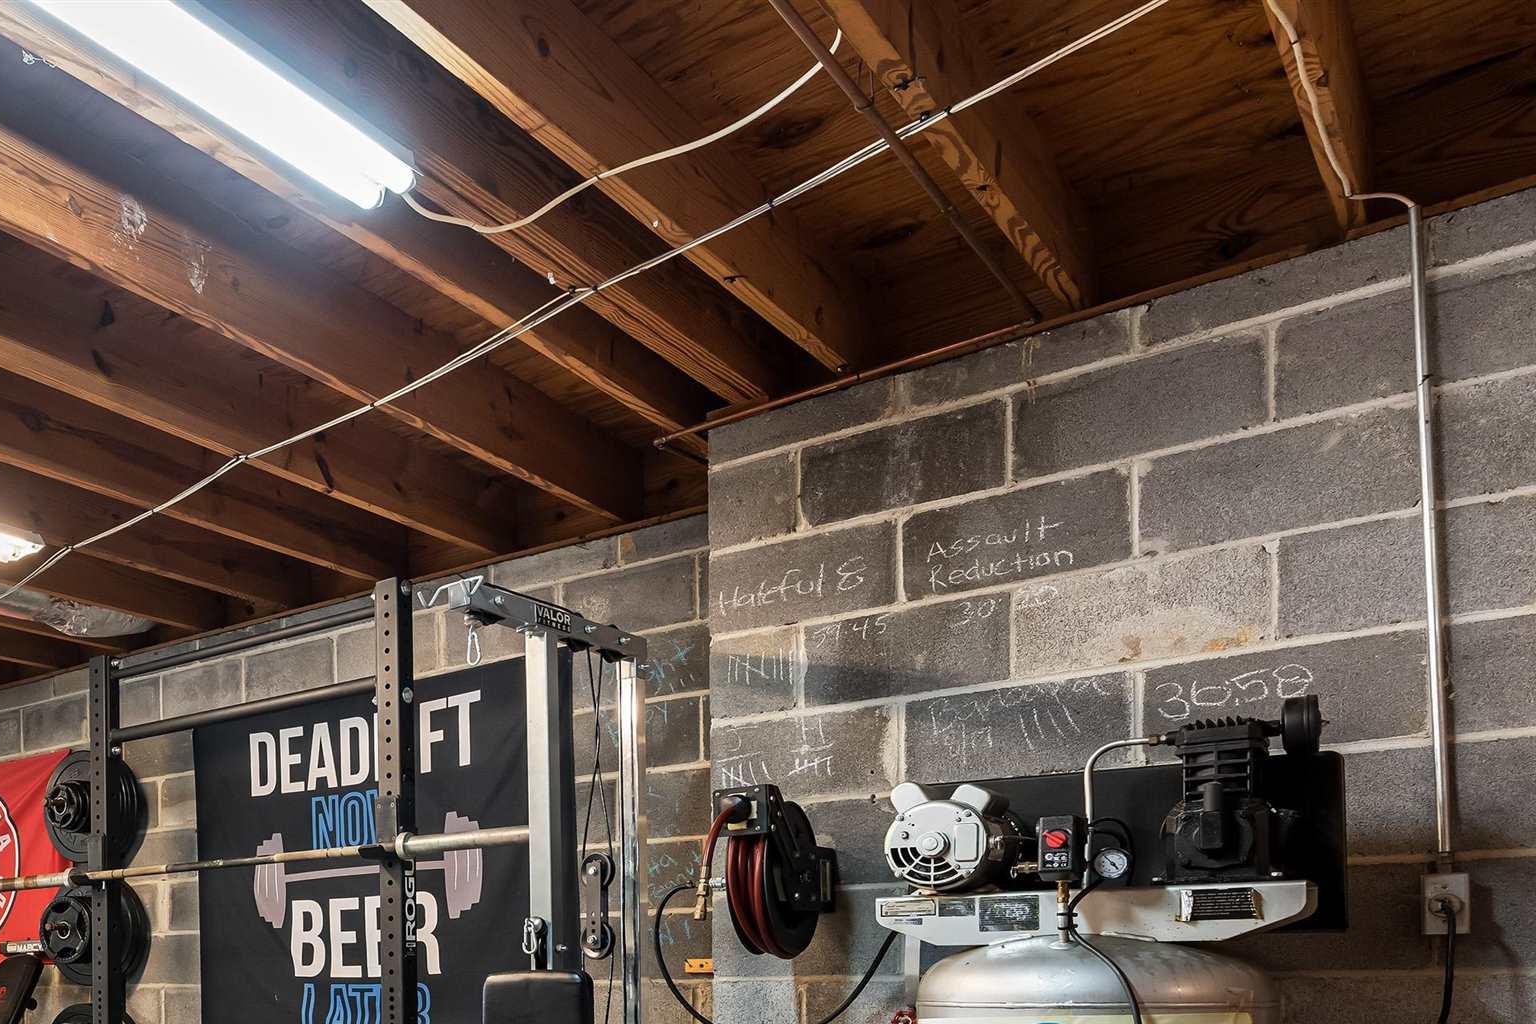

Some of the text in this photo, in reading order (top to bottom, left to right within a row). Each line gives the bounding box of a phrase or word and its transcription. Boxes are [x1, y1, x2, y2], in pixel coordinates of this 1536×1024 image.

[926, 516, 1065, 562] Assault
[928, 550, 1074, 592] Reduction
[536, 606, 571, 626] VALOR
[537, 618, 571, 633] FITNESS
[249, 690, 481, 797] DEADFT
[311, 789, 378, 850] NO
[404, 858, 416, 941] ROGU
